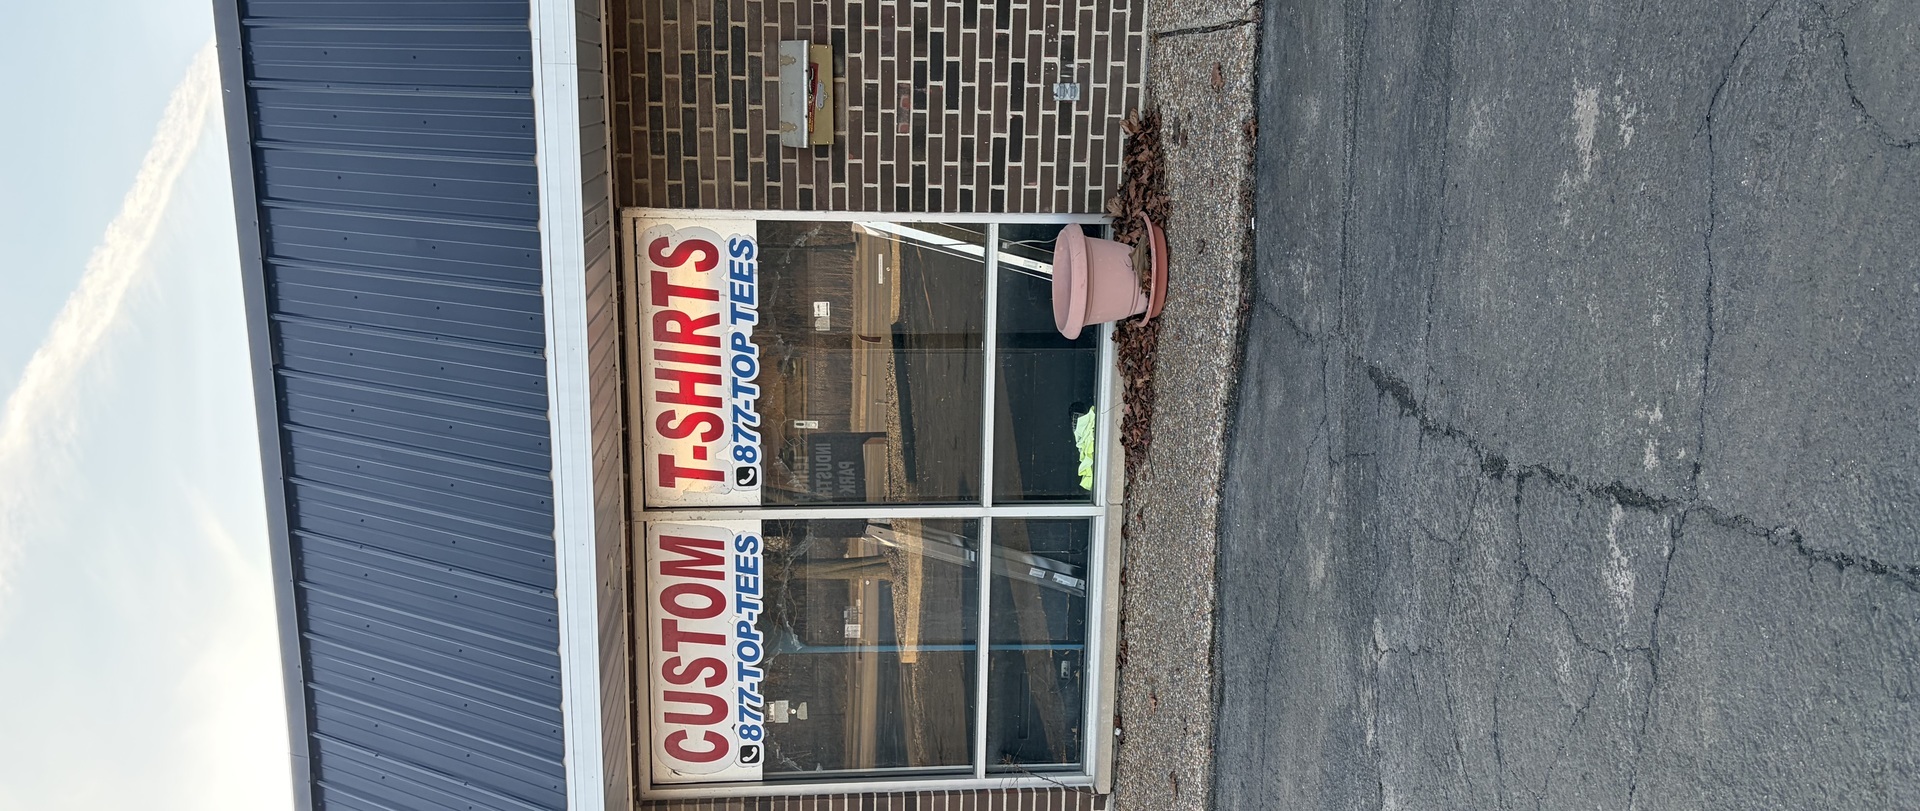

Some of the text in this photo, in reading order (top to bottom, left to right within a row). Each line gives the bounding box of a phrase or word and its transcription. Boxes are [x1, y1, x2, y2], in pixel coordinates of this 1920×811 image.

[648, 236, 725, 489] T-SHIRTS
[729, 238, 757, 464] 877-TOP TEES
[659, 535, 729, 763] CUSTOM
[734, 535, 762, 741] 877-TOP-TEES
